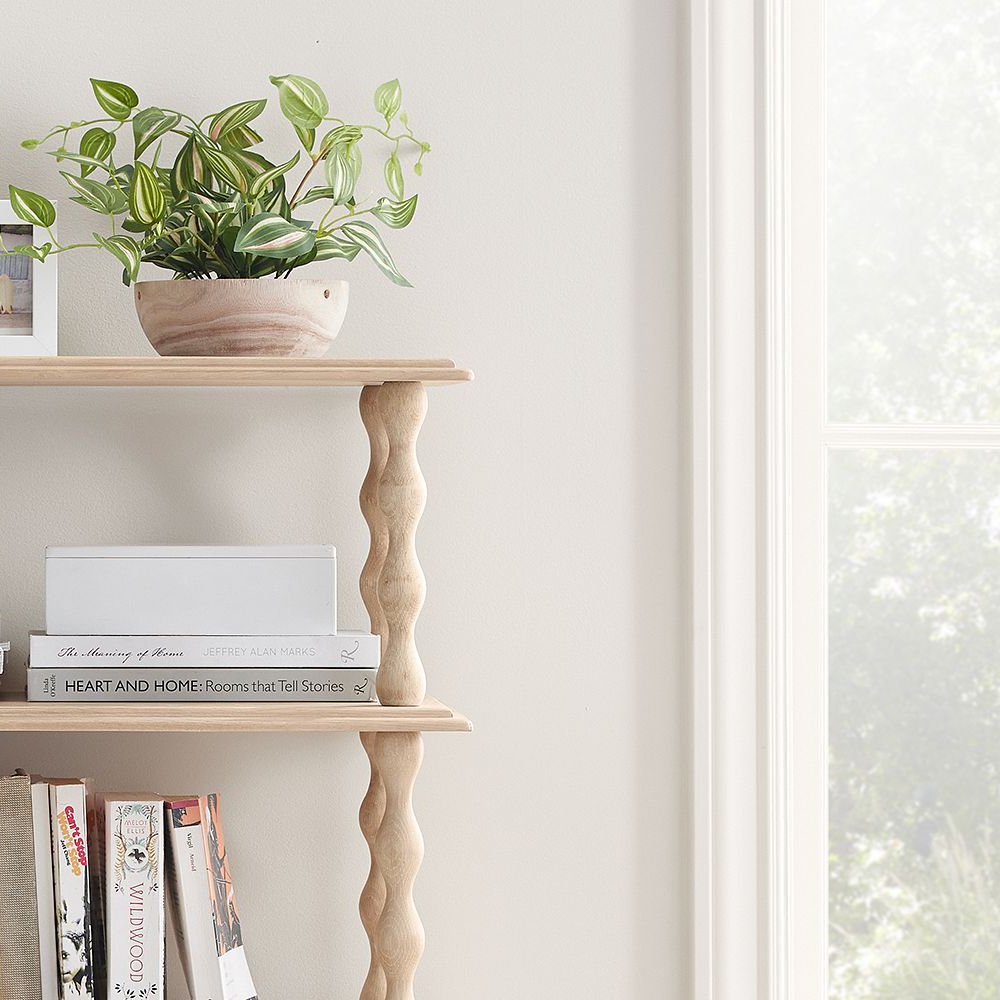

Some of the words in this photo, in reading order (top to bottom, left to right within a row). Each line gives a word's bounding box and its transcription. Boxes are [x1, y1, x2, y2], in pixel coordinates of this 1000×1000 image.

[57, 646, 78, 658] The
[81, 646, 132, 664] Meaning
[136, 650, 149, 661] of
[151, 647, 184, 657] Home
[203, 648, 247, 657] JEFFREY
[250, 648, 277, 657] ALAN
[280, 648, 316, 657] MARKS
[65, 679, 113, 692] HEART
[115, 679, 150, 692] AND
[154, 679, 203, 692] HOME:
[205, 679, 249, 693] Rooms
[252, 680, 277, 693] that
[278, 679, 298, 692] Tell
[301, 679, 344, 693] Stories
[64, 805, 81, 838] Can't
[74, 837, 87, 866] Stop
[68, 848, 82, 877] Stop
[129, 882, 145, 983] WILDWOOD
